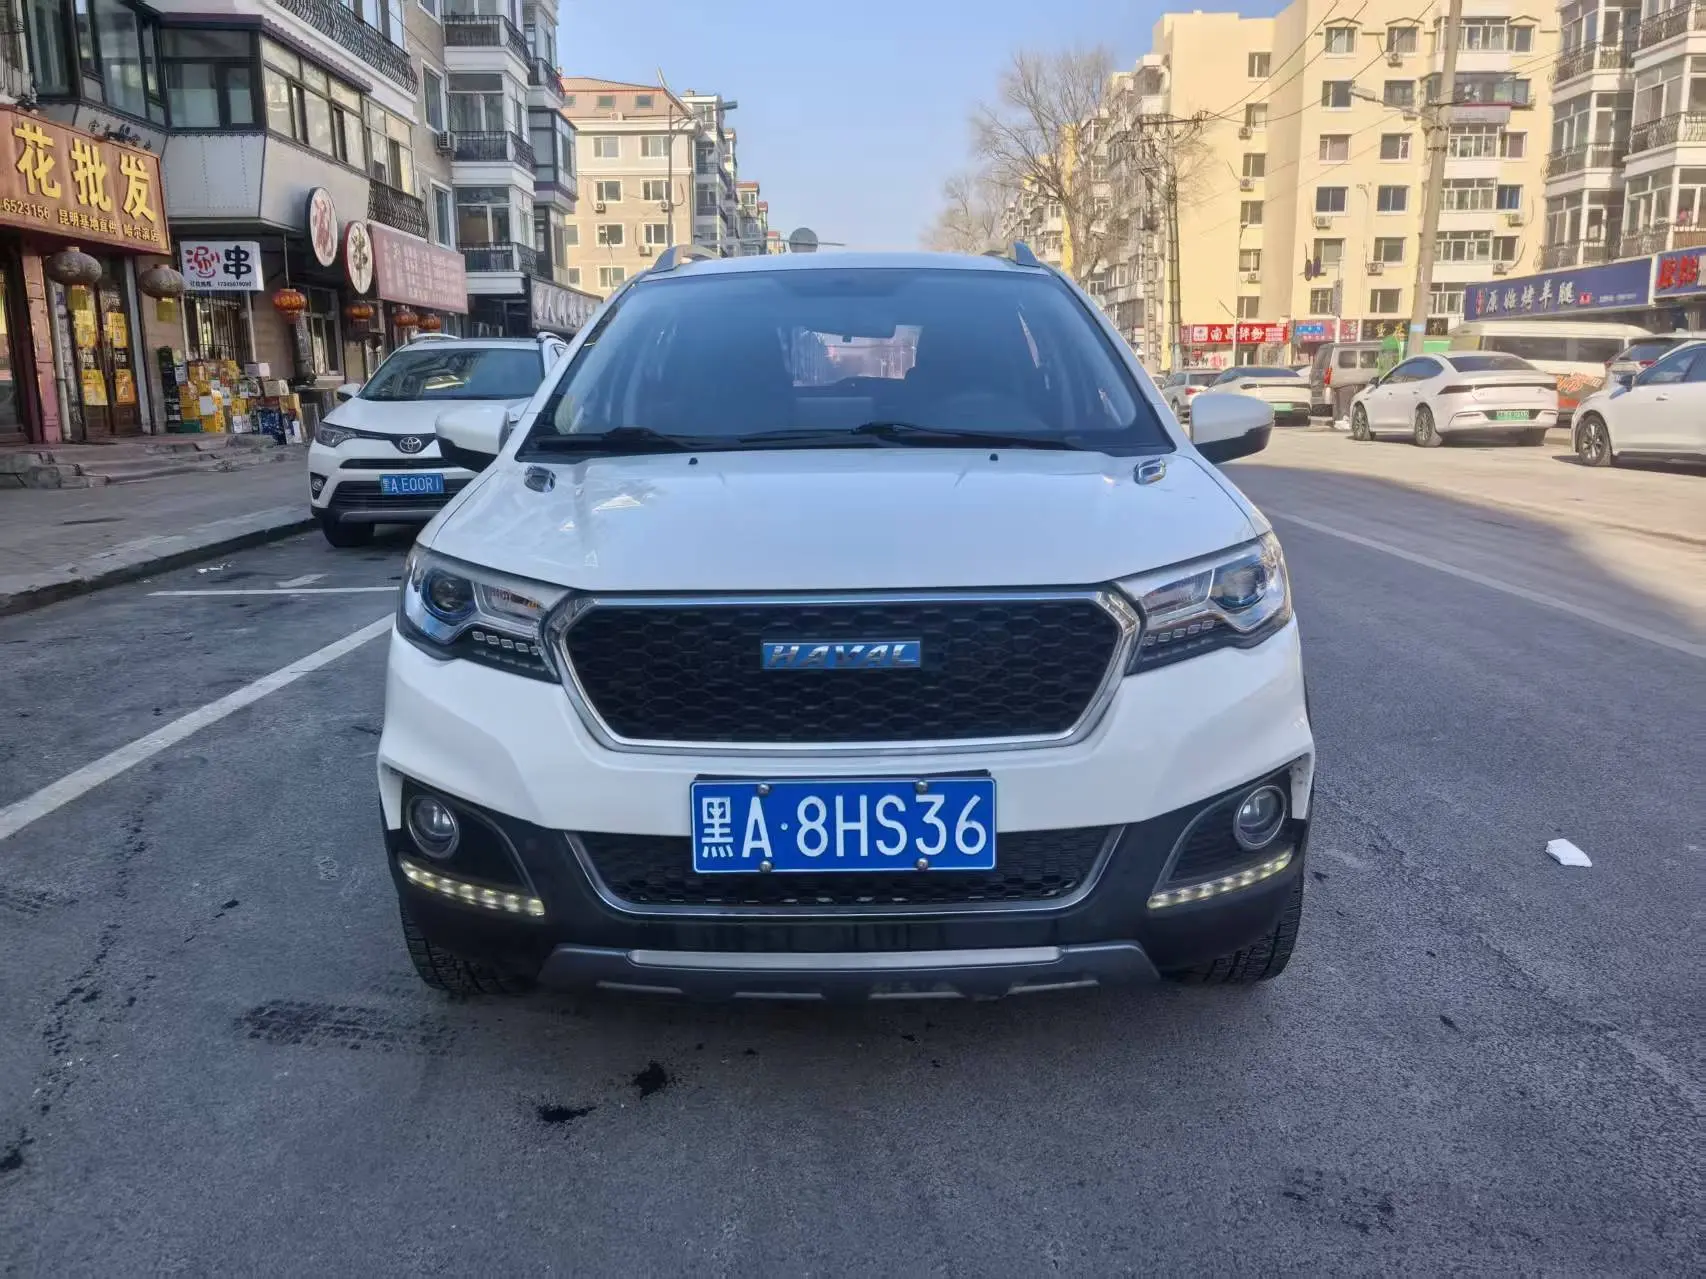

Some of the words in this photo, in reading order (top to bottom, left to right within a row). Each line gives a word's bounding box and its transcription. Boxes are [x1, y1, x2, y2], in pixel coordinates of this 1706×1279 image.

[14, 120, 157, 223] 花批发
[768, 643, 917, 667] HAVAL
[701, 794, 988, 858] 黑A·8HS36
